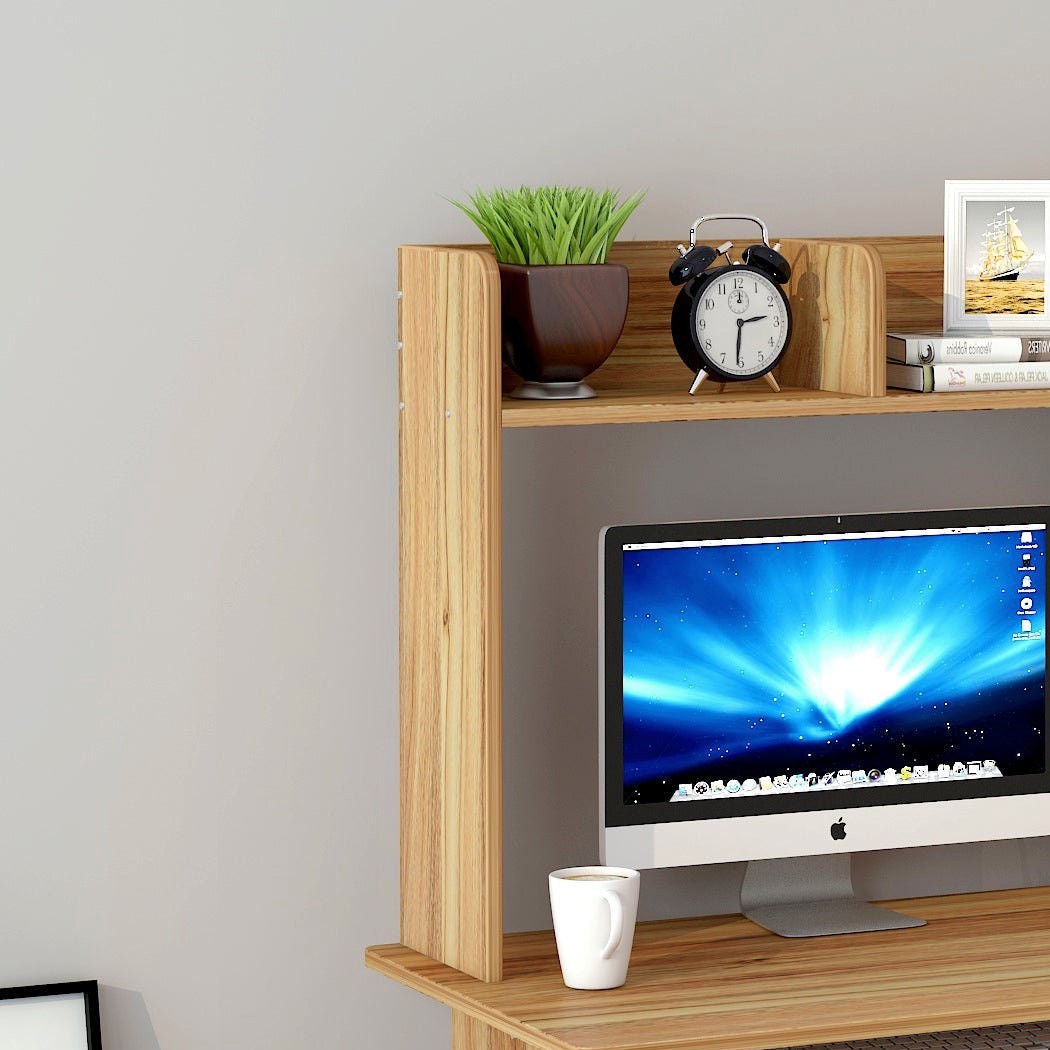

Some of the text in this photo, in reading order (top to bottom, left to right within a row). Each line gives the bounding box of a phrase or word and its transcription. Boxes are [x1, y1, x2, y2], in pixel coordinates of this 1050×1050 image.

[718, 283, 726, 295] 11
[733, 278, 744, 289] 12
[754, 282, 759, 294] 1
[705, 298, 715, 310] 10
[766, 296, 774, 307] 2
[699, 319, 706, 330] 9
[773, 316, 780, 328] 3
[705, 339, 712, 350] 8
[767, 336, 775, 347] 4
[719, 352, 727, 364] 7
[757, 351, 764, 362] 5
[738, 356, 745, 369] 6
